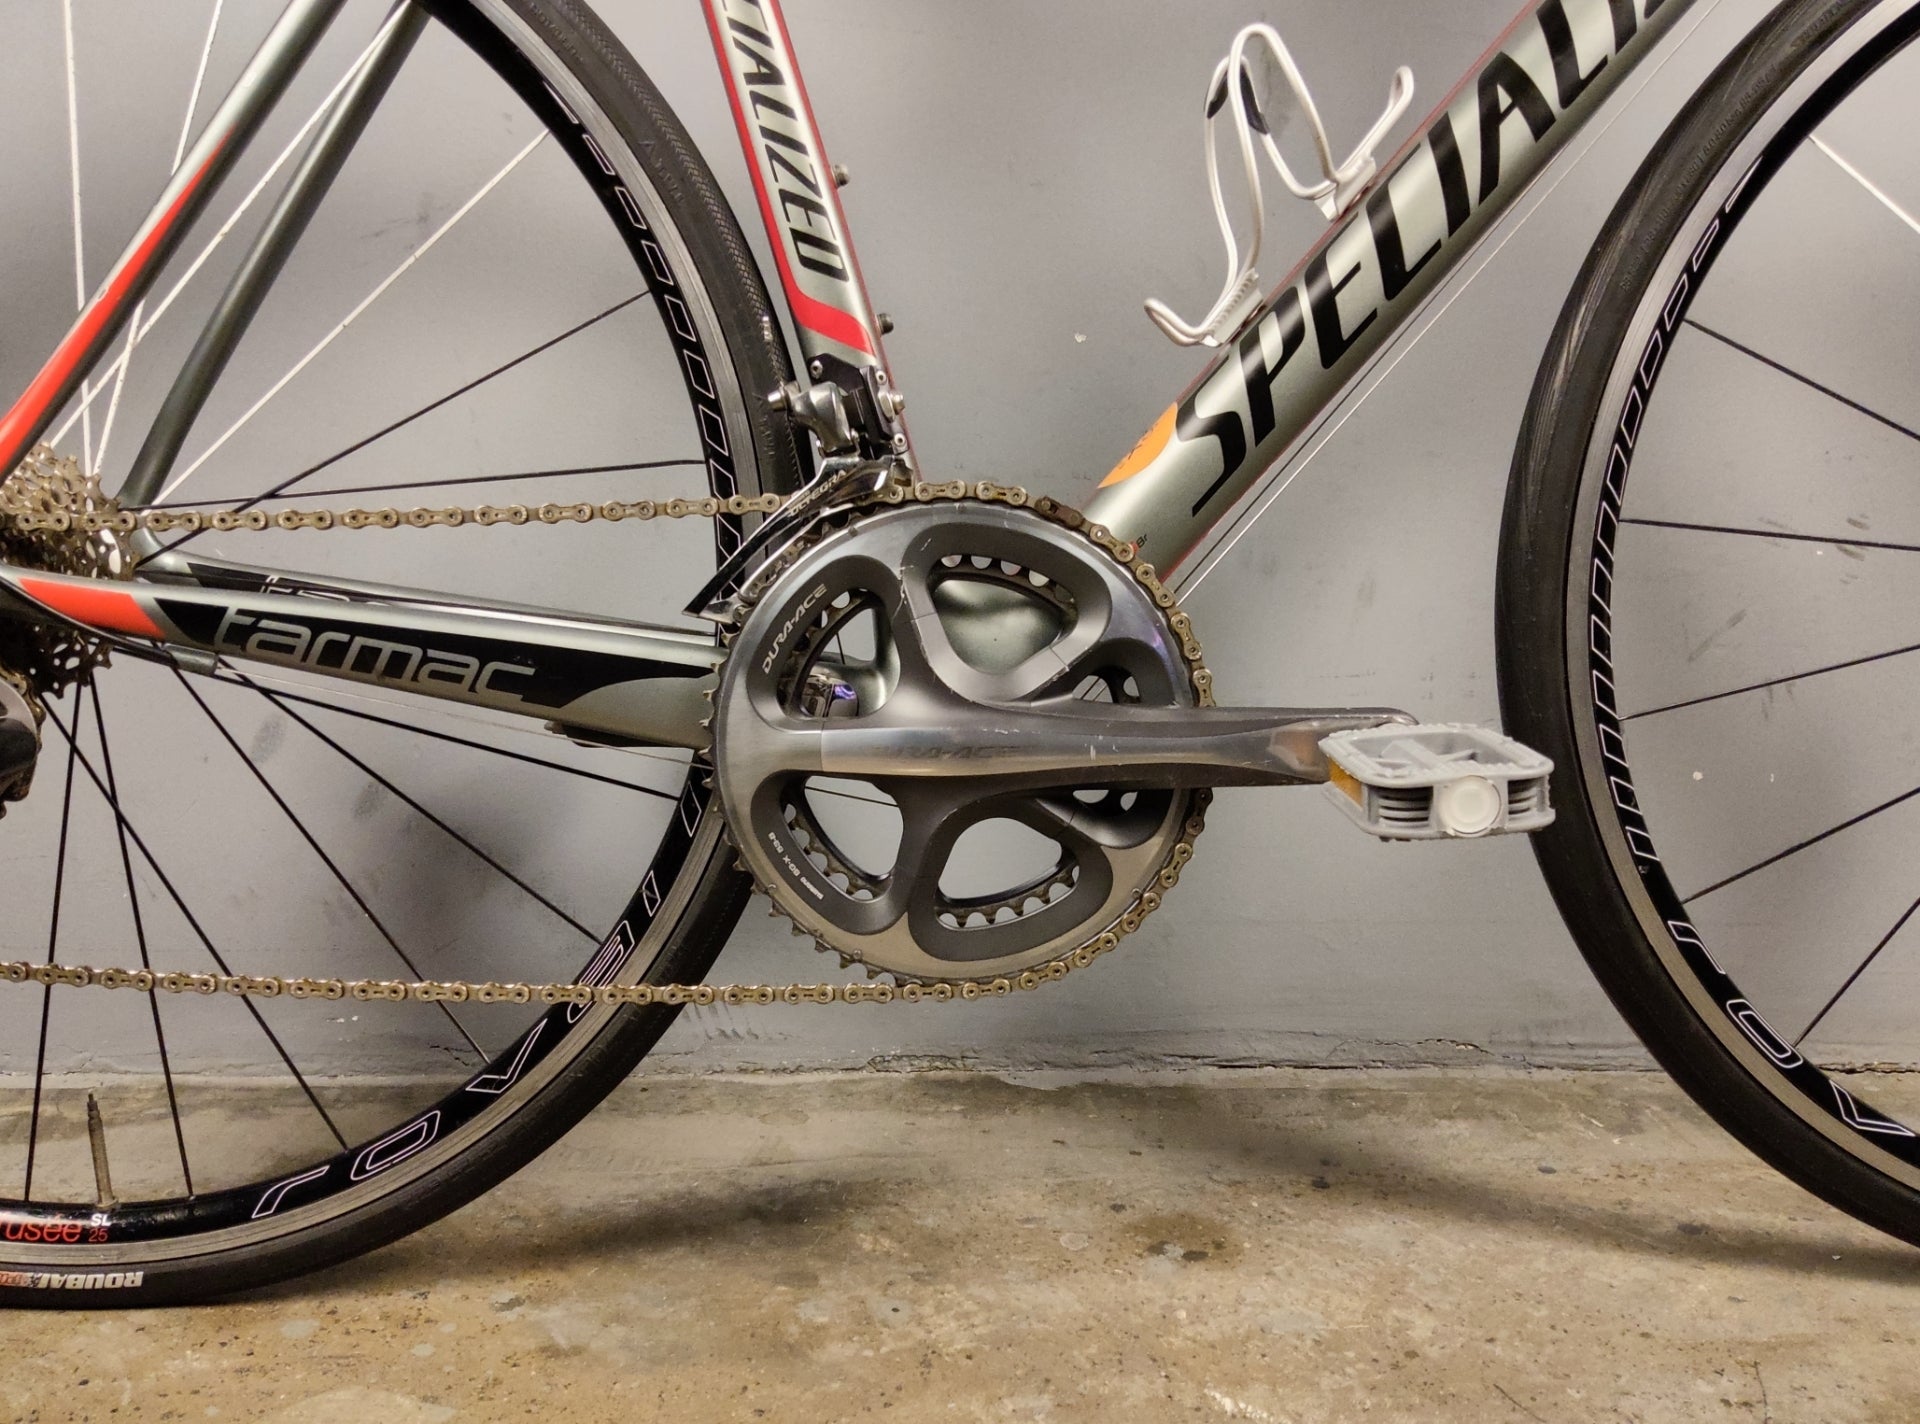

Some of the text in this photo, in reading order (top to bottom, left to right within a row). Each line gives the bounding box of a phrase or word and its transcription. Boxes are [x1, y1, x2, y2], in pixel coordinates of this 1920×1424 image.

[1175, 0, 1666, 518] SPECIAL
[213, 606, 537, 702] tarmac
[762, 583, 828, 674] DURA-ACE
[0, 1213, 112, 1243] usée SL
[88, 1228, 108, 1242] 25
[28, 1271, 144, 1290] ROUBAI
